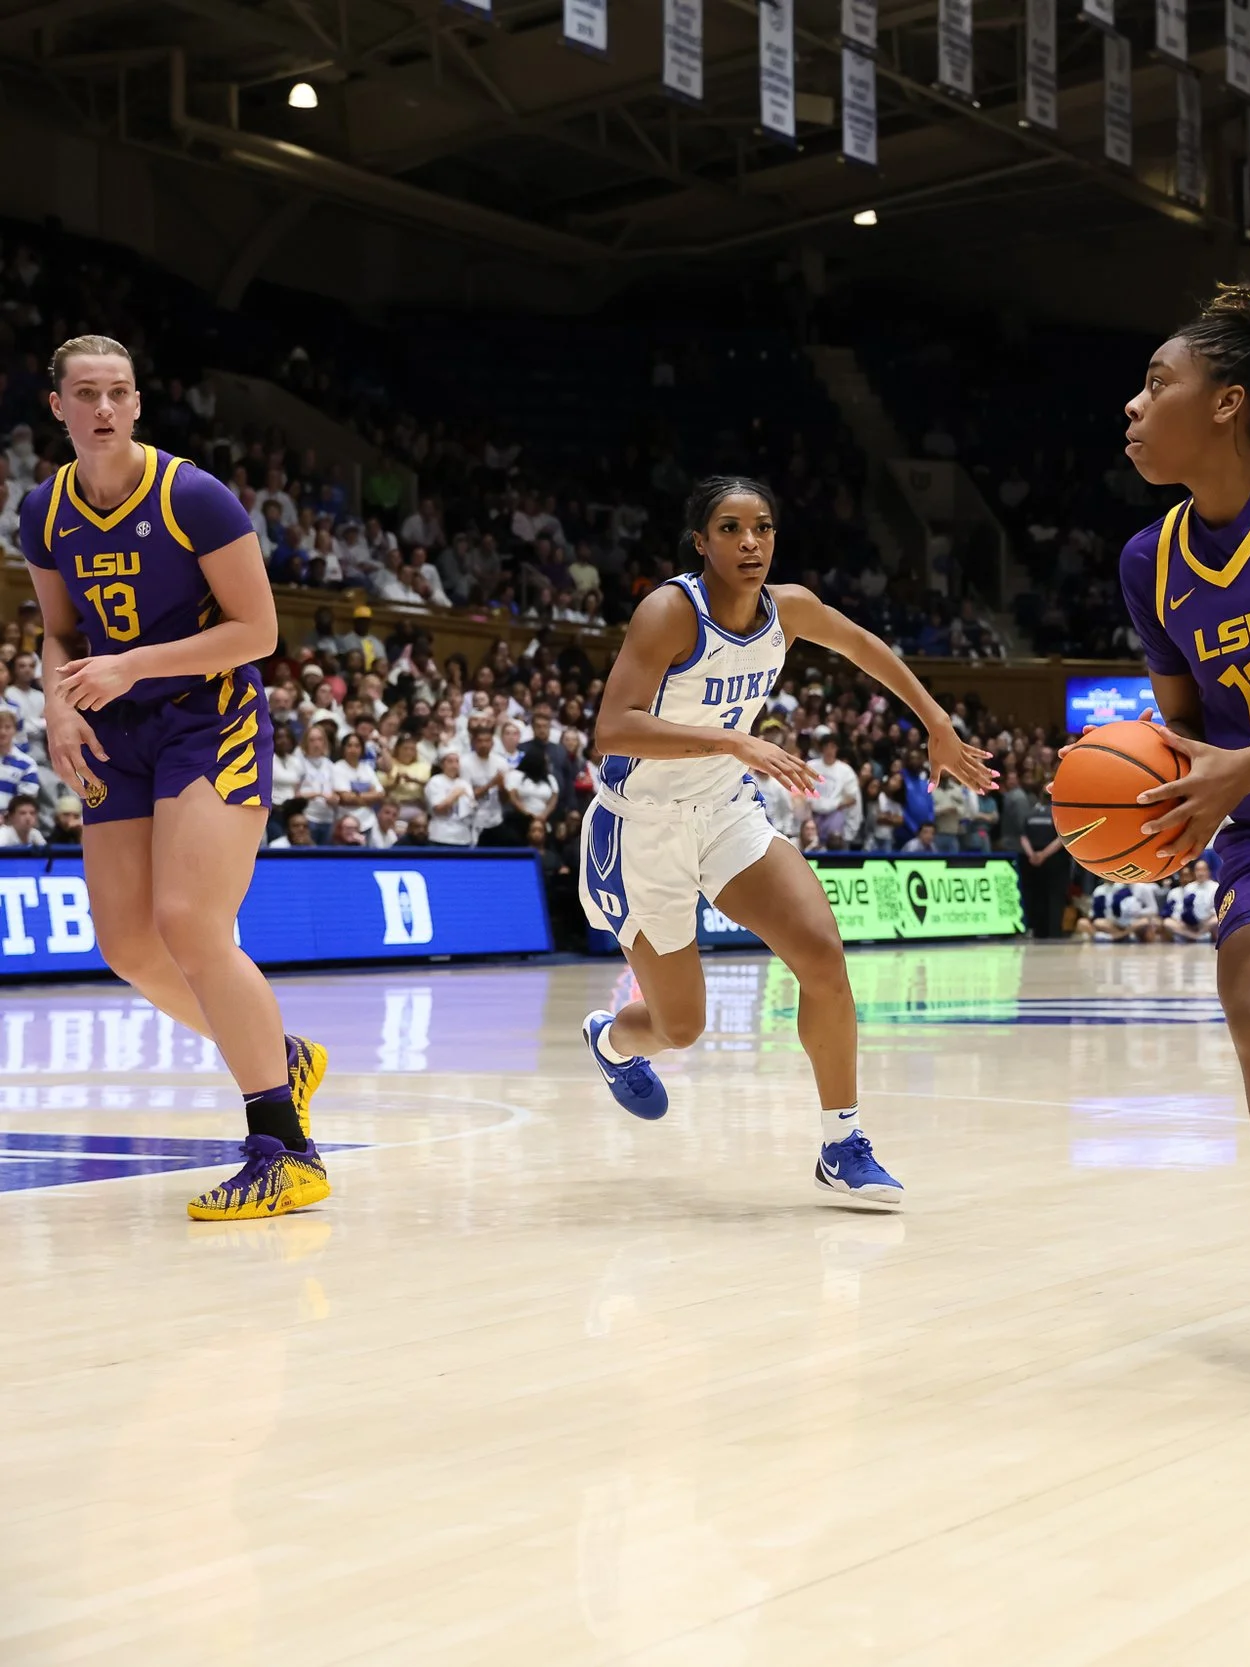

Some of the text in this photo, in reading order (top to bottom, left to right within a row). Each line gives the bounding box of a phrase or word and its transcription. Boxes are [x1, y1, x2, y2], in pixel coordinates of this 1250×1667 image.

[75, 552, 141, 578] LSU
[83, 581, 141, 642] 13
[701, 668, 778, 706] DUKE
[596, 888, 623, 918] D
[826, 877, 870, 906] ave
[930, 877, 991, 904] wave
[372, 870, 434, 945] D
